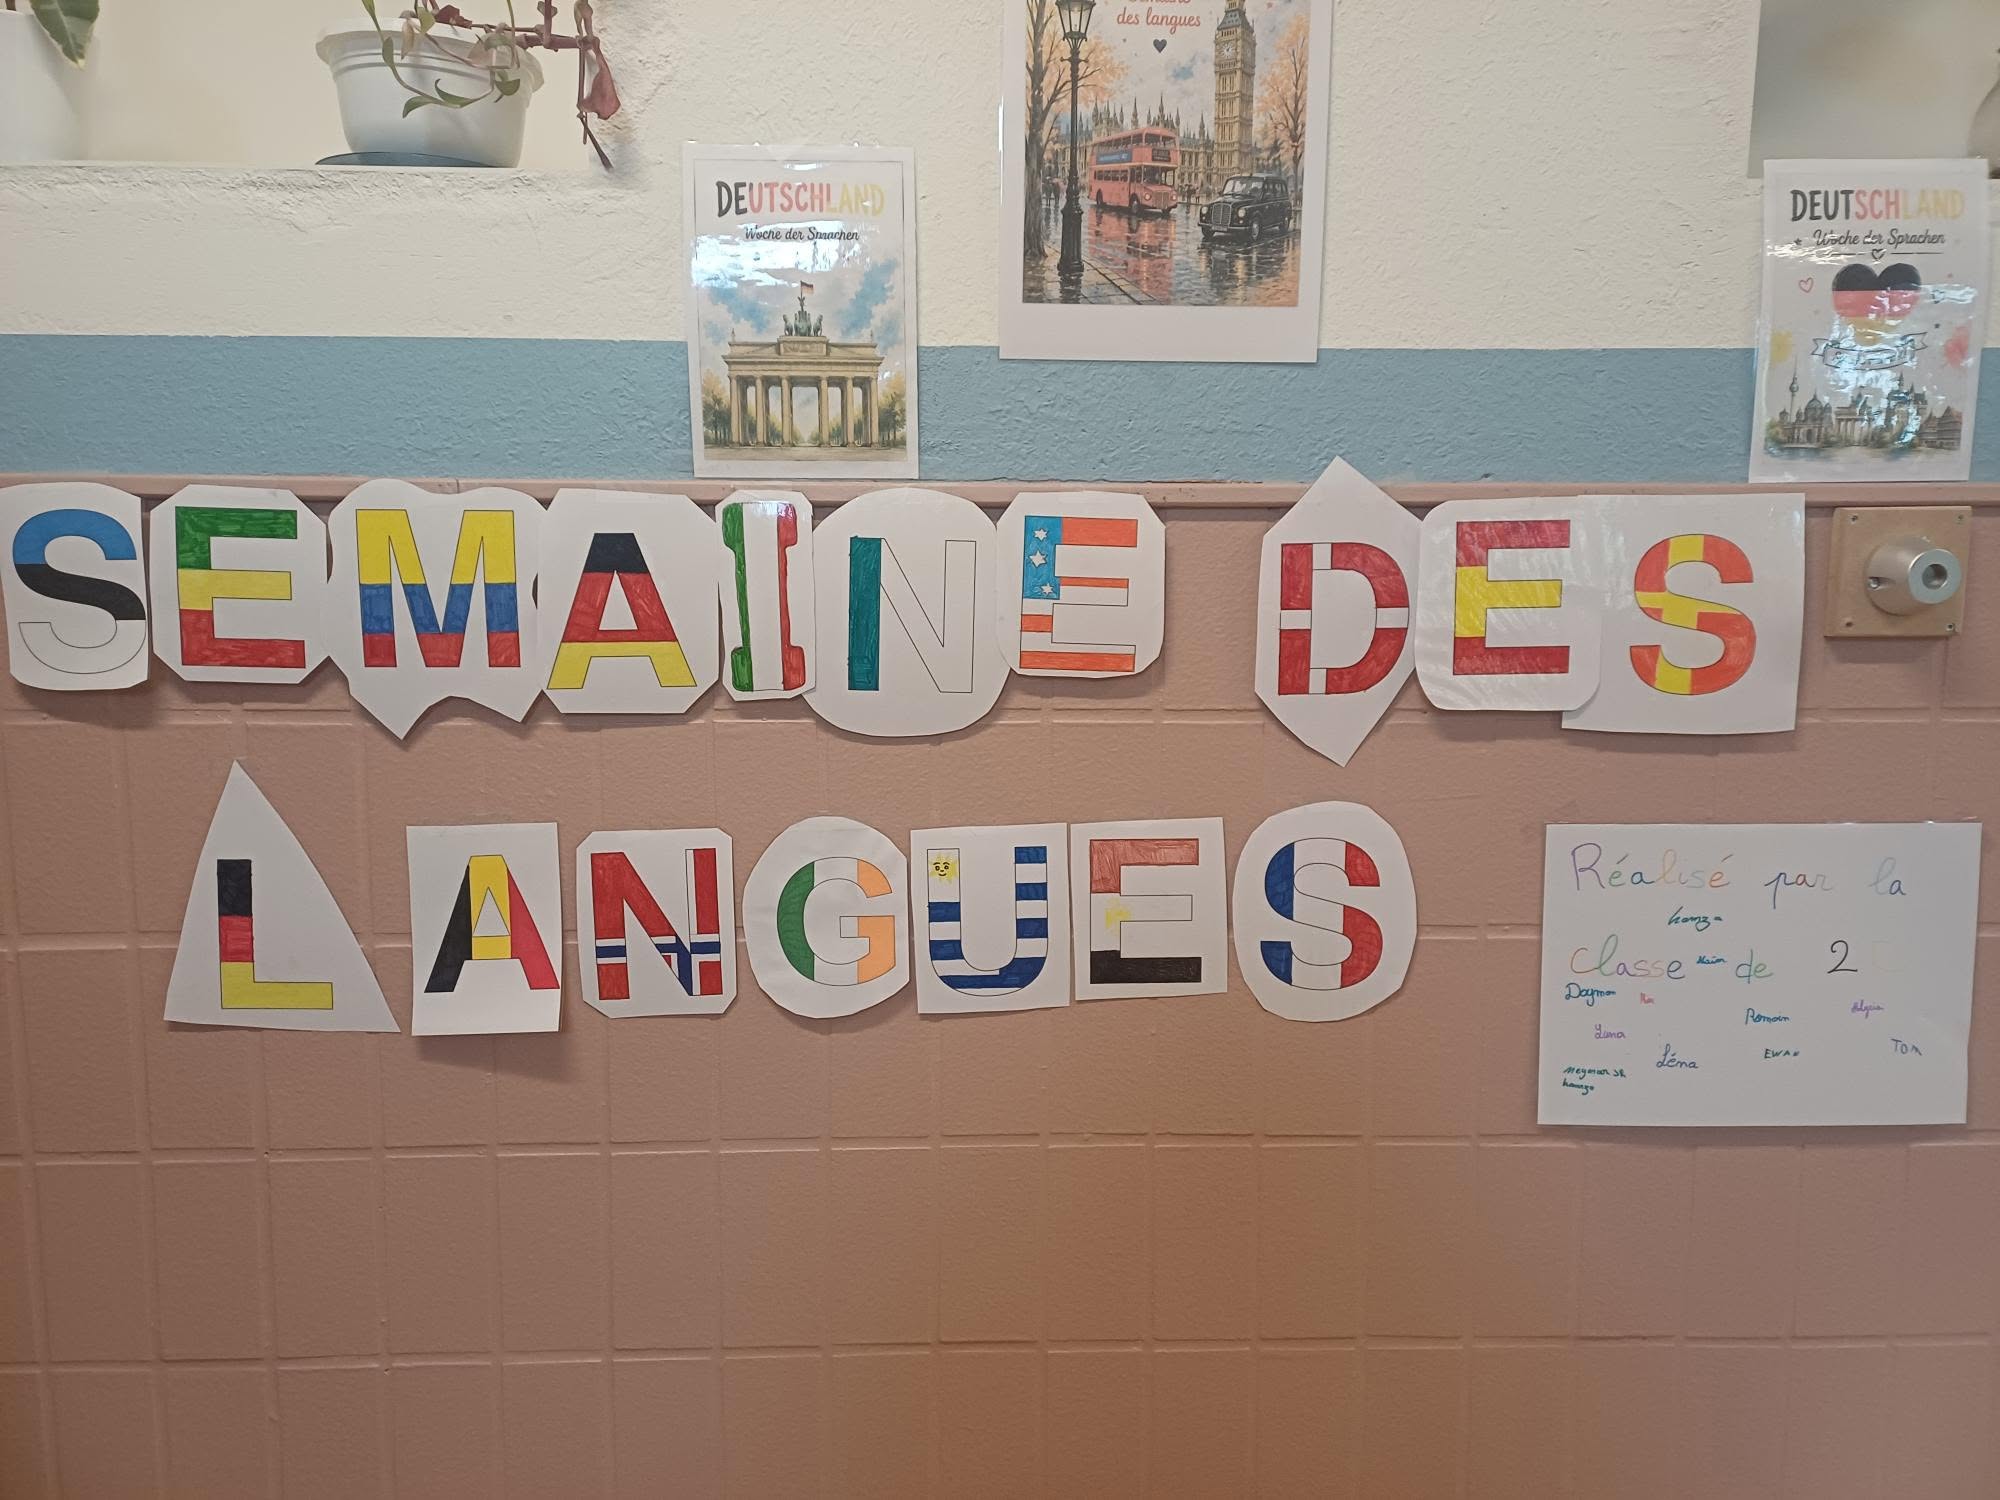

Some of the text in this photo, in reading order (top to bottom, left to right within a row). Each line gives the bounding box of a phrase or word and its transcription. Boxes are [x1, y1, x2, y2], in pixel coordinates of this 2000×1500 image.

[1116, 6, 1201, 35] des langues
[715, 181, 885, 218] DEUTSCHLAND
[1790, 187, 1965, 222] DEUTSCHLAND
[785, 228, 804, 240] der
[1813, 228, 1946, 250] Woche der Sprachen
[12, 502, 1757, 696] SEMAINE DES
[1571, 842, 1907, 910] Réalisé par la
[216, 837, 1384, 1009] LANGUES
[1735, 948, 1775, 984] de
